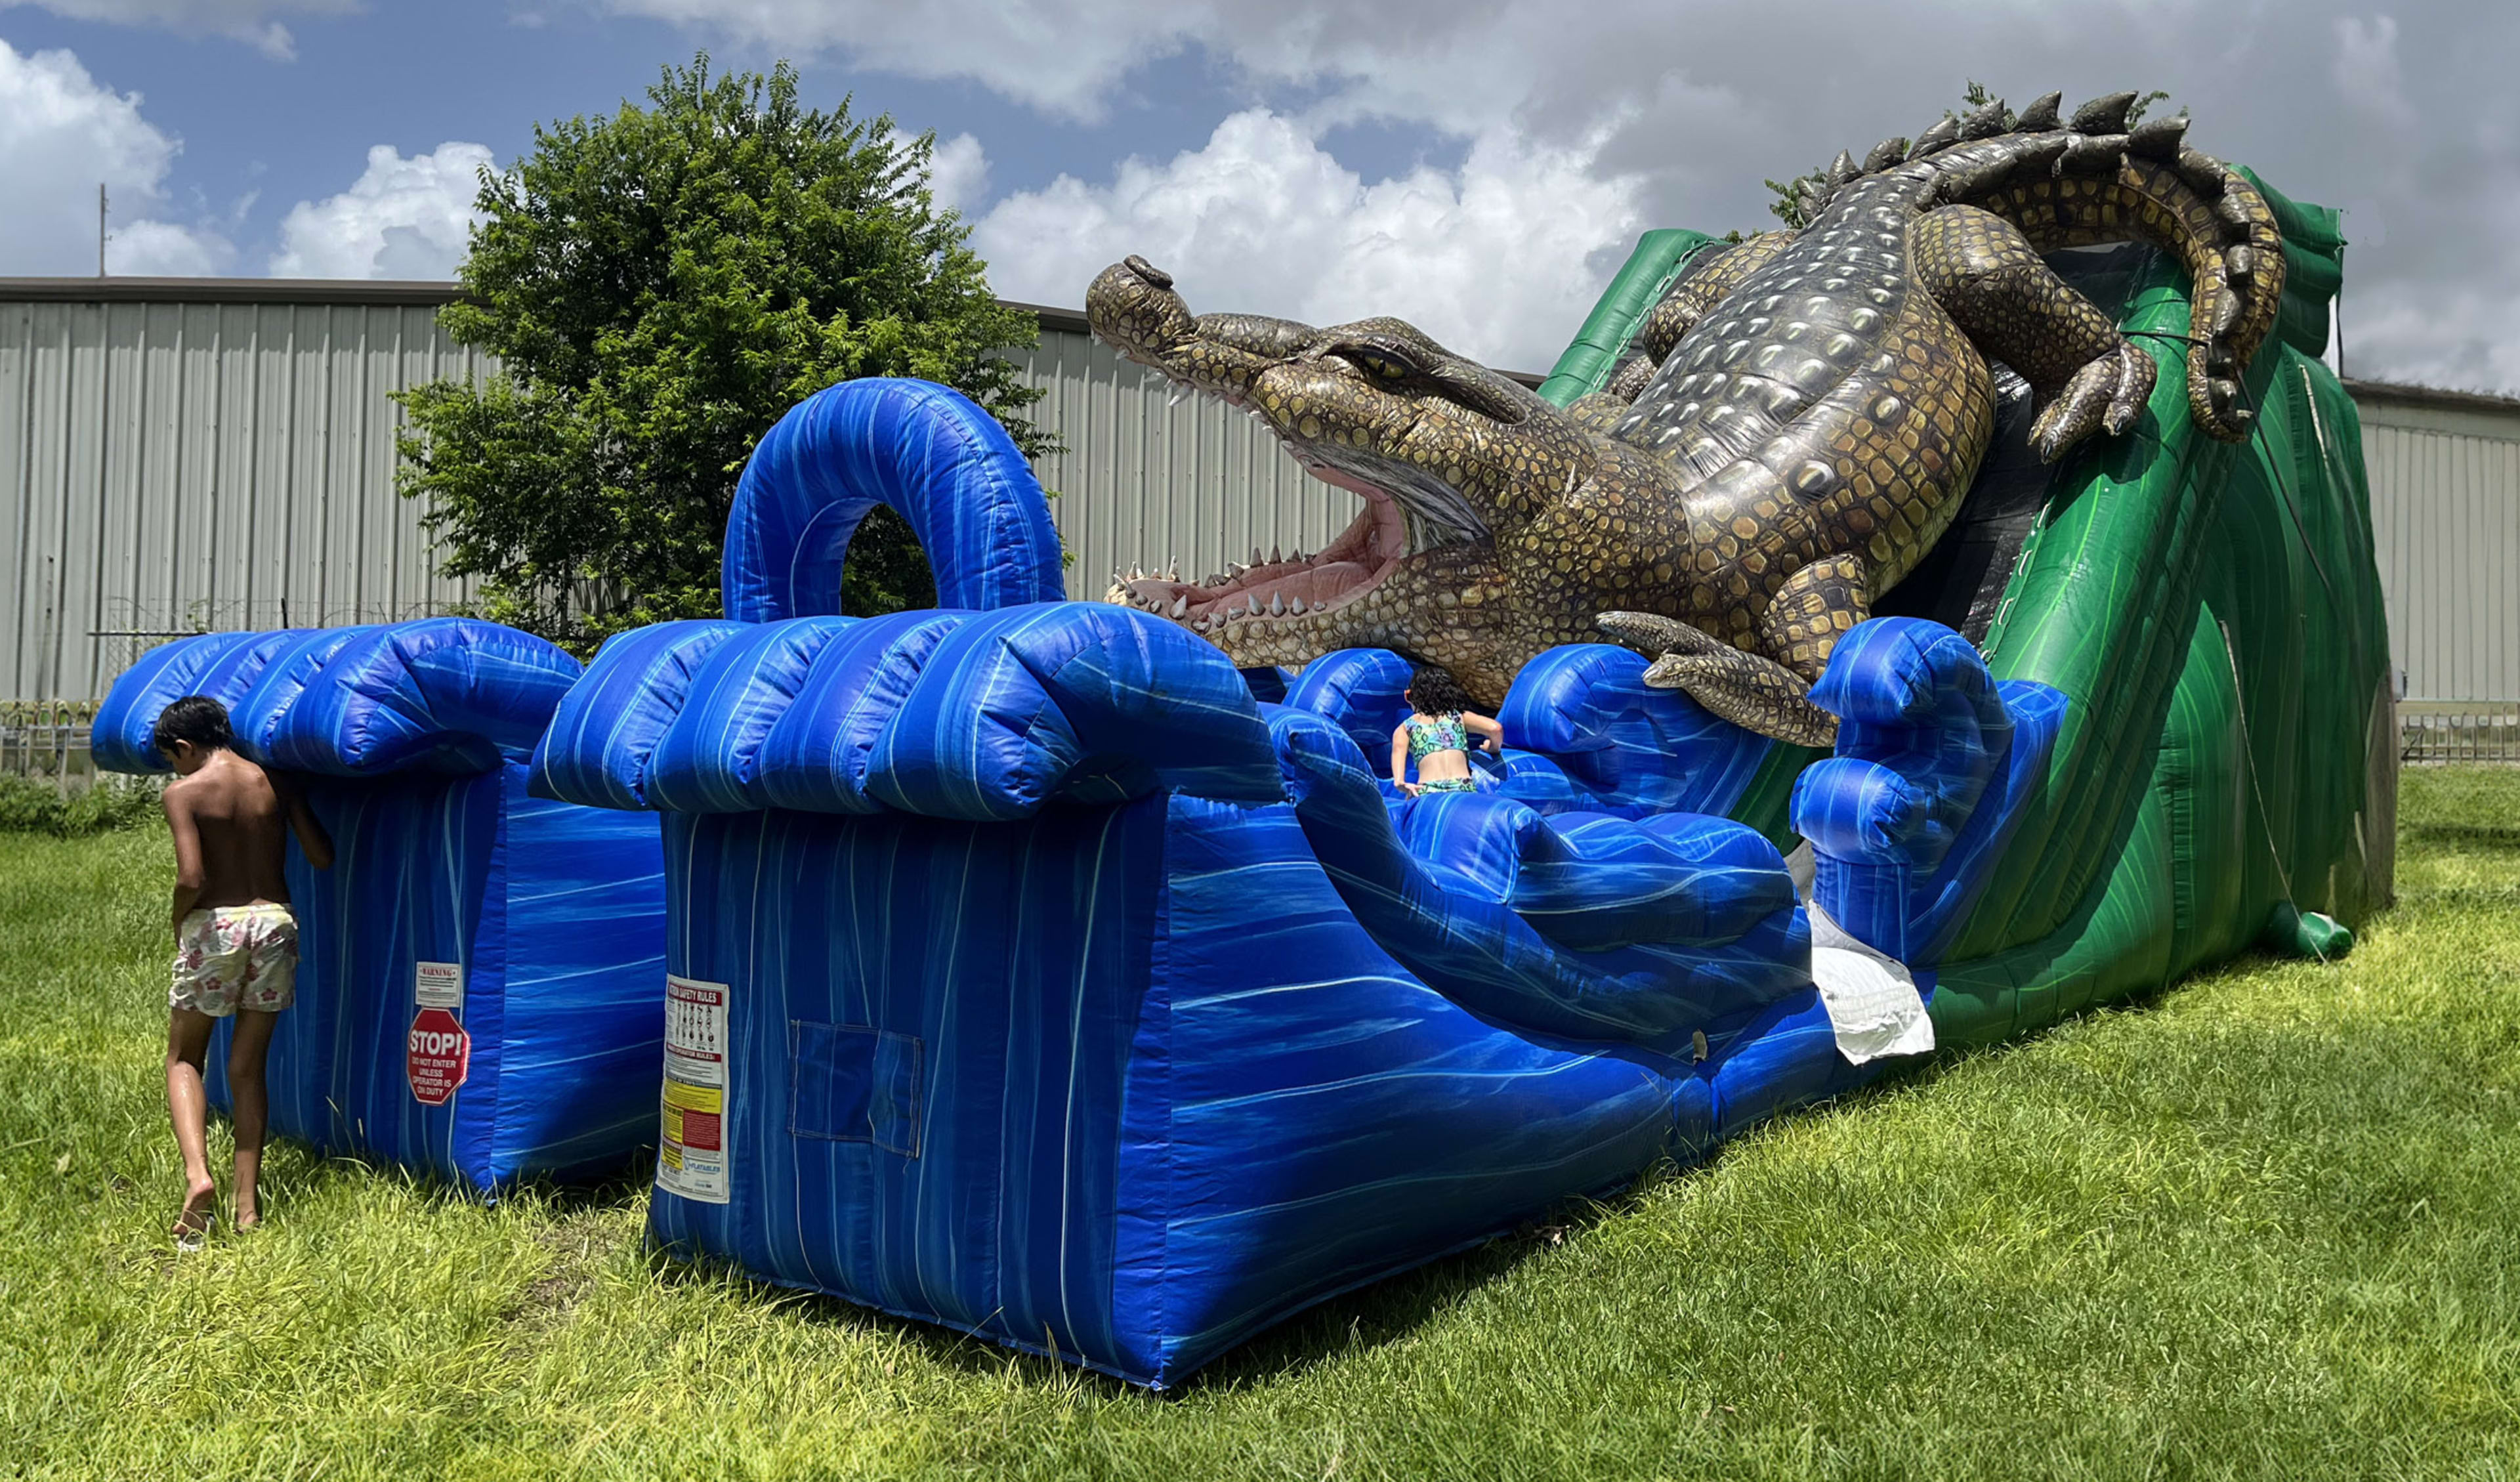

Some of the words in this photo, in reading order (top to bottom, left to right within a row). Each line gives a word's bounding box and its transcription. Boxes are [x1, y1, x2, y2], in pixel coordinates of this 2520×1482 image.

[423, 967, 452, 977] WARNING
[679, 987, 697, 1000] SAFETY
[697, 990, 717, 1004] RULES
[410, 1029, 463, 1056] STOP!
[411, 1056, 419, 1065] DO
[420, 1057, 431, 1067] NOT
[432, 1059, 456, 1069] ENTER
[419, 1068, 444, 1078] UNLESS
[413, 1076, 443, 1087] OPERATOR
[444, 1079, 452, 1088] IS
[417, 1086, 426, 1094] ON
[426, 1087, 444, 1097] DUTY
